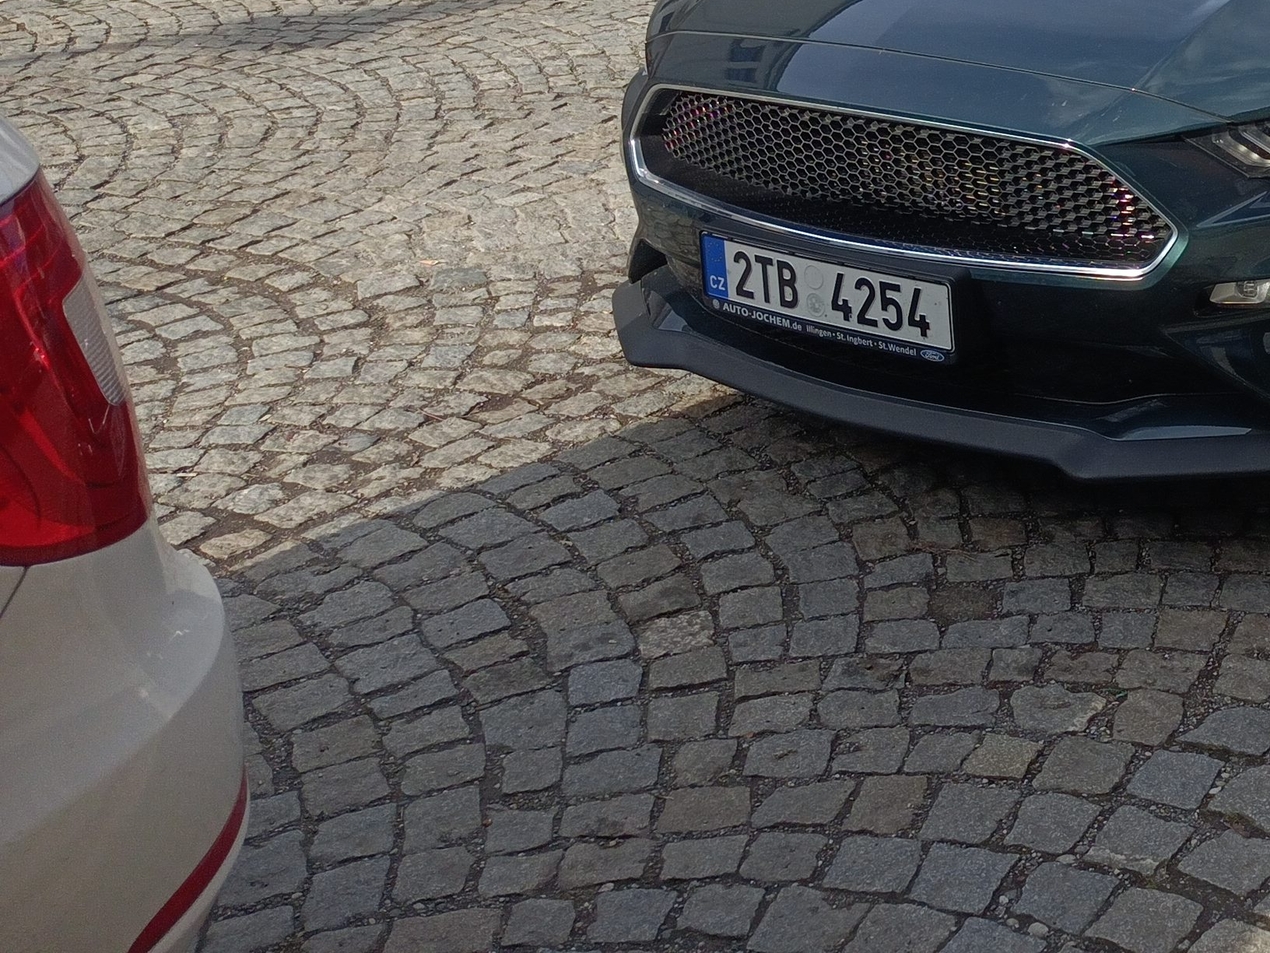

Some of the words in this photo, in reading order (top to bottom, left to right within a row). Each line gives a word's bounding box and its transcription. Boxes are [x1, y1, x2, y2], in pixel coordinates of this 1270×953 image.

[709, 275, 726, 291] CZ
[733, 251, 798, 309] 2TB
[831, 273, 930, 338] 4254
